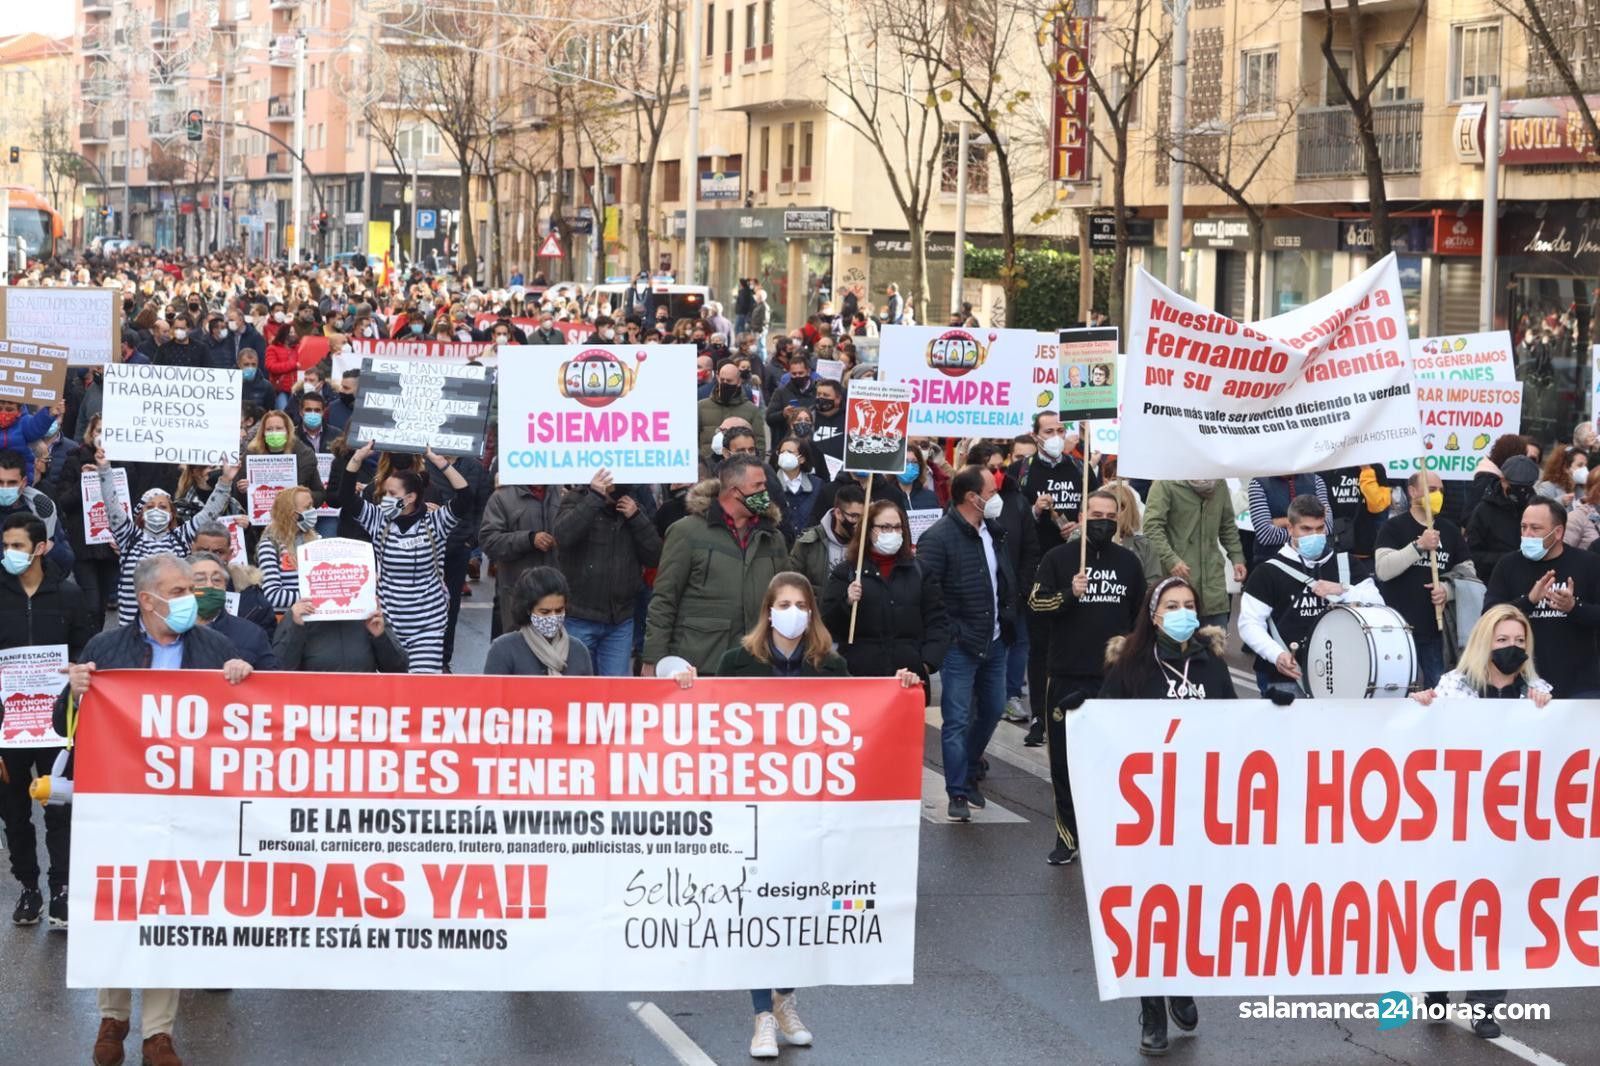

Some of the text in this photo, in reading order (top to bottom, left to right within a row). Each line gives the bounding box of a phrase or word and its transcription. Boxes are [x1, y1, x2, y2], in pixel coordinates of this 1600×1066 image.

[1057, 19, 1088, 181] HOTEL
[1510, 117, 1561, 150] HOTEL
[421, 212, 432, 227] P
[886, 241, 912, 251] FLE
[1149, 298, 1238, 336] Nuestro
[1374, 289, 1391, 307] a
[1145, 327, 1290, 374] Fernando
[1435, 350, 1507, 368] GENERAMOS
[104, 364, 236, 383] AUTONOMOS Y
[1145, 366, 1175, 387] por
[1183, 371, 1212, 392] su
[108, 381, 235, 401] TRABAJADORES
[366, 393, 386, 406] NO
[1446, 388, 1521, 405] IMPUESTOS
[142, 400, 206, 417] PRESOS
[1143, 402, 1182, 417] Porque
[1183, 407, 1203, 420] más
[1204, 410, 1226, 422] vale
[1228, 413, 1248, 423] ser
[1295, 395, 1352, 415] diciendo
[1353, 392, 1367, 404] la
[1368, 383, 1411, 401] verdad
[132, 416, 210, 430] DE VUESTRAS
[915, 409, 931, 425] LA
[1199, 423, 1218, 435] que
[1262, 421, 1286, 433] con
[1287, 419, 1299, 430] la
[1300, 410, 1351, 428] mentira
[1425, 409, 1504, 428] ACTIVIDAD
[104, 427, 165, 444] PELEAS
[396, 421, 436, 433] CASAS
[528, 411, 670, 444] ¡SIEMPRE
[507, 450, 548, 469] CON
[551, 450, 575, 468] LA
[1047, 479, 1074, 491] ZONA
[1332, 486, 1350, 497] VAN
[1085, 567, 1117, 580] ZONA
[1100, 580, 1127, 596] DYCK
[1166, 679, 1206, 698] ZONA
[5, 697, 54, 707] AUTÓNOMO
[5, 704, 54, 713] SALAMANC
[141, 693, 863, 752] NO SE PUEDE EXIGIR IMPUESTOS,
[145, 745, 857, 797] SI PROHIBES TENER INGRESOS
[1115, 718, 1600, 846] SÍ LA HOSTELE
[290, 805, 713, 836] DE LA HOSTELERÍA VIVIMOS MUCHOS
[259, 839, 318, 853] personal,
[321, 840, 385, 853] carnicero,
[387, 840, 456, 854] pescadero,
[459, 840, 505, 853] frutero,
[507, 841, 570, 855] panadero,
[572, 841, 645, 855] publicistas,
[646, 844, 653, 855] y
[656, 843, 672, 854] un
[674, 841, 707, 856] largo
[709, 842, 732, 854] etc.
[94, 860, 548, 921] ¡¡AYUDAS YA!!
[757, 880, 877, 901] design&print
[139, 924, 508, 950] NUESTRA MUERTE ESTÁ EN TUS MANOS
[625, 909, 882, 949] CON LA HOSTELERÍA
[1100, 878, 1501, 979] SALAMANCA
